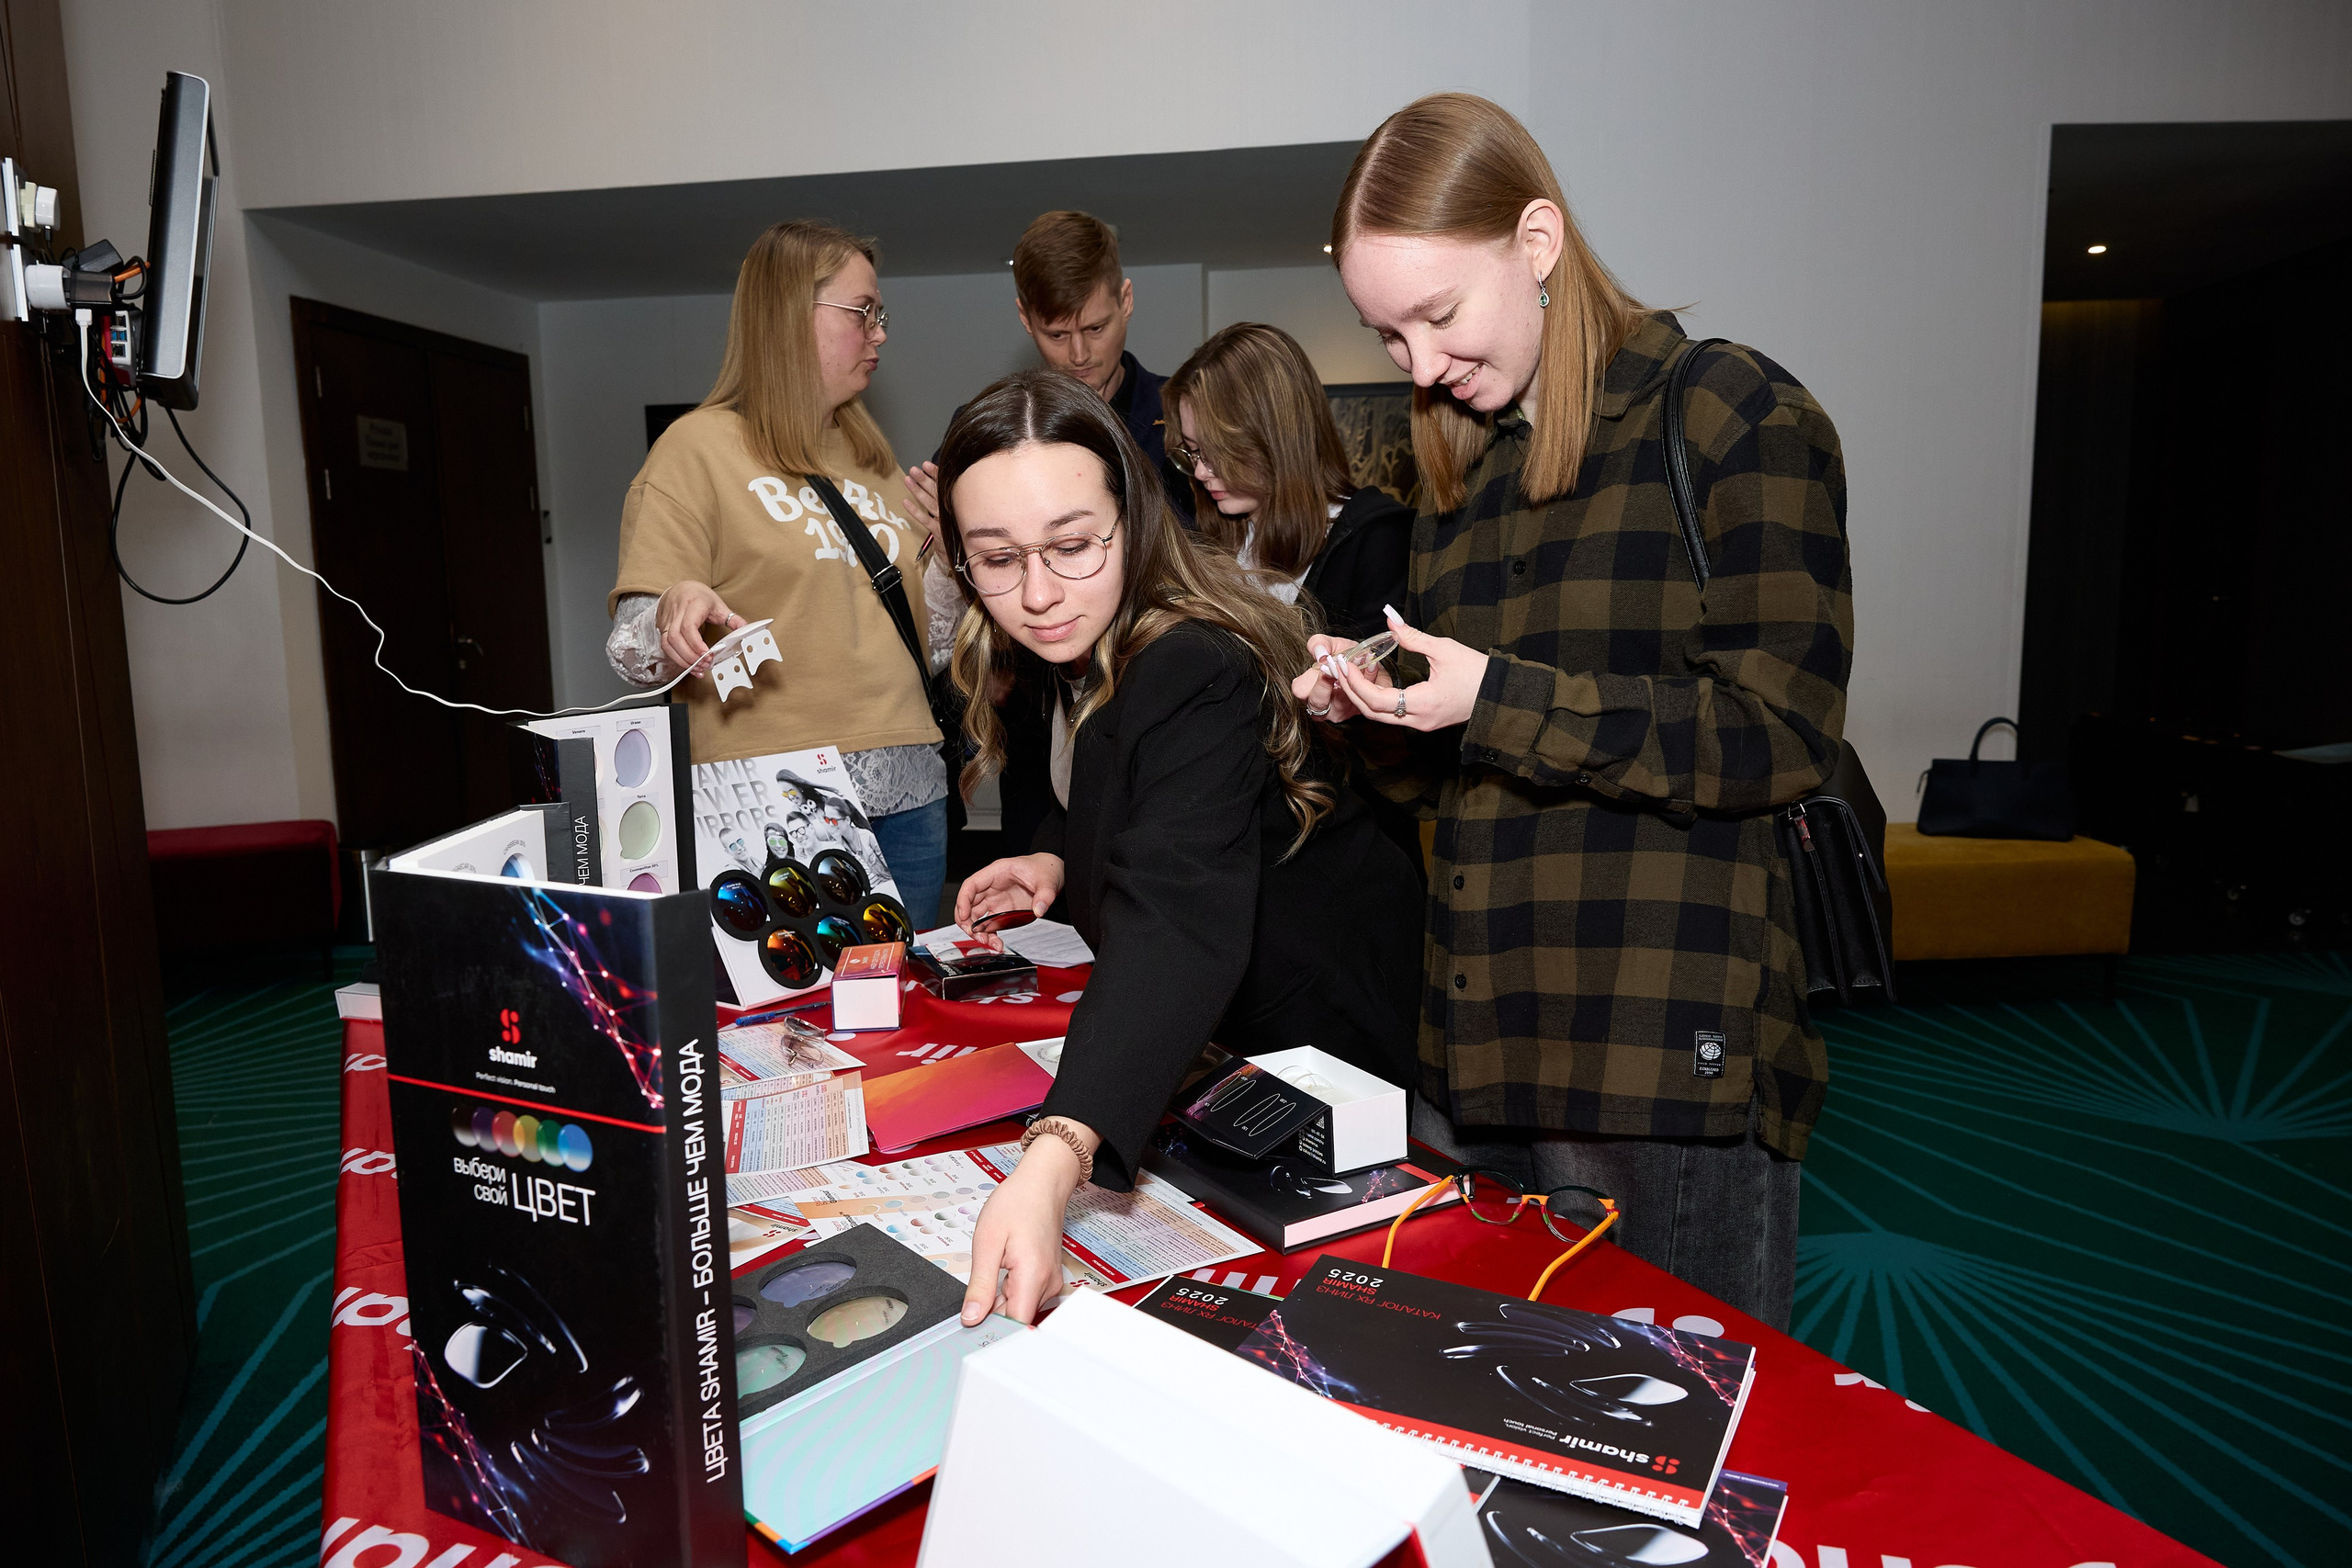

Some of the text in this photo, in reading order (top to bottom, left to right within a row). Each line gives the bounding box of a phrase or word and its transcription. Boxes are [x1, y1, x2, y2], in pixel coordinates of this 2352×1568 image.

[816, 765, 837, 774] shamir
[574, 815, 590, 855] МОДА
[489, 1046, 537, 1069] shamir
[475, 1071, 496, 1082] Perfect
[514, 1077, 537, 1090] Personal
[678, 1038, 706, 1117] МОДА
[684, 1120, 707, 1176] ЧЕМ
[454, 1157, 506, 1184] выбери
[474, 1183, 508, 1206] свой
[512, 1172, 596, 1226] ЦВЕТ
[687, 1177, 714, 1289] БОЛЬШЕ
[770, 1224, 798, 1233] shamir
[1084, 1271, 1108, 1287] shamir
[1322, 1277, 1377, 1295] SHAMIR
[1328, 1269, 1385, 1288] 2025
[1169, 1294, 1220, 1312] SHAMIR
[1176, 1288, 1228, 1305] 2025
[1316, 1285, 1442, 1320] КАТАЛОГ RX ЛИНЗ
[1160, 1302, 1258, 1330] ТАЛОГ RX ЛИНЗ
[696, 1308, 721, 1402] SHAMIR
[1503, 1417, 1558, 1437] Personal touch
[1529, 1428, 1556, 1440] Perfect
[702, 1401, 729, 1483] ЦВЕТА
[1559, 1434, 1651, 1464] shamir
